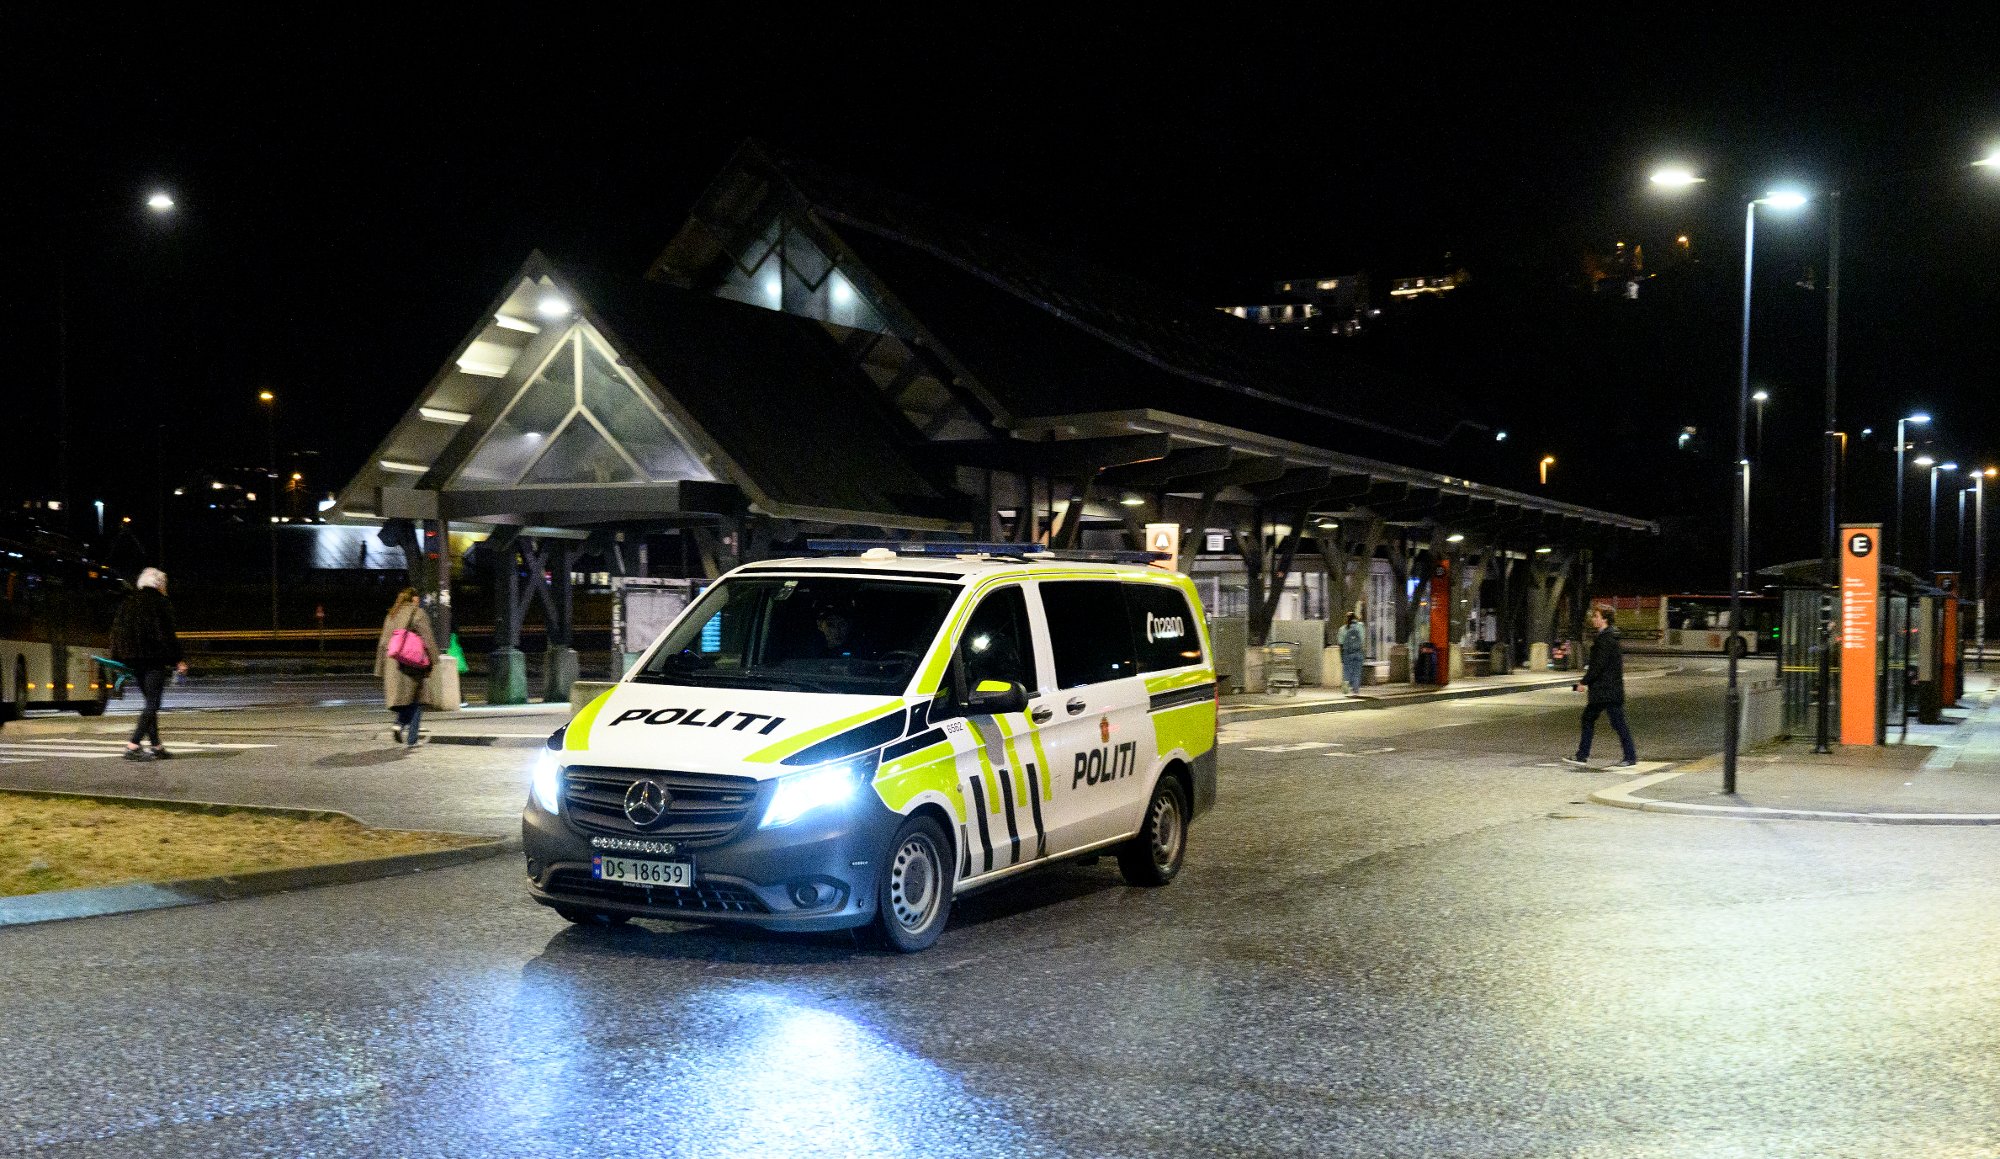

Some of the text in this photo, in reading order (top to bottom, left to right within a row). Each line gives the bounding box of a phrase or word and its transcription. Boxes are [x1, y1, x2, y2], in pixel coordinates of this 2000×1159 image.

[1852, 536, 1868, 552] E
[1153, 616, 1185, 639] 02800
[608, 708, 787, 736] POLITI
[946, 721, 964, 734] 6562
[1071, 740, 1137, 790] POLITI
[606, 859, 684, 884] DS 18659
